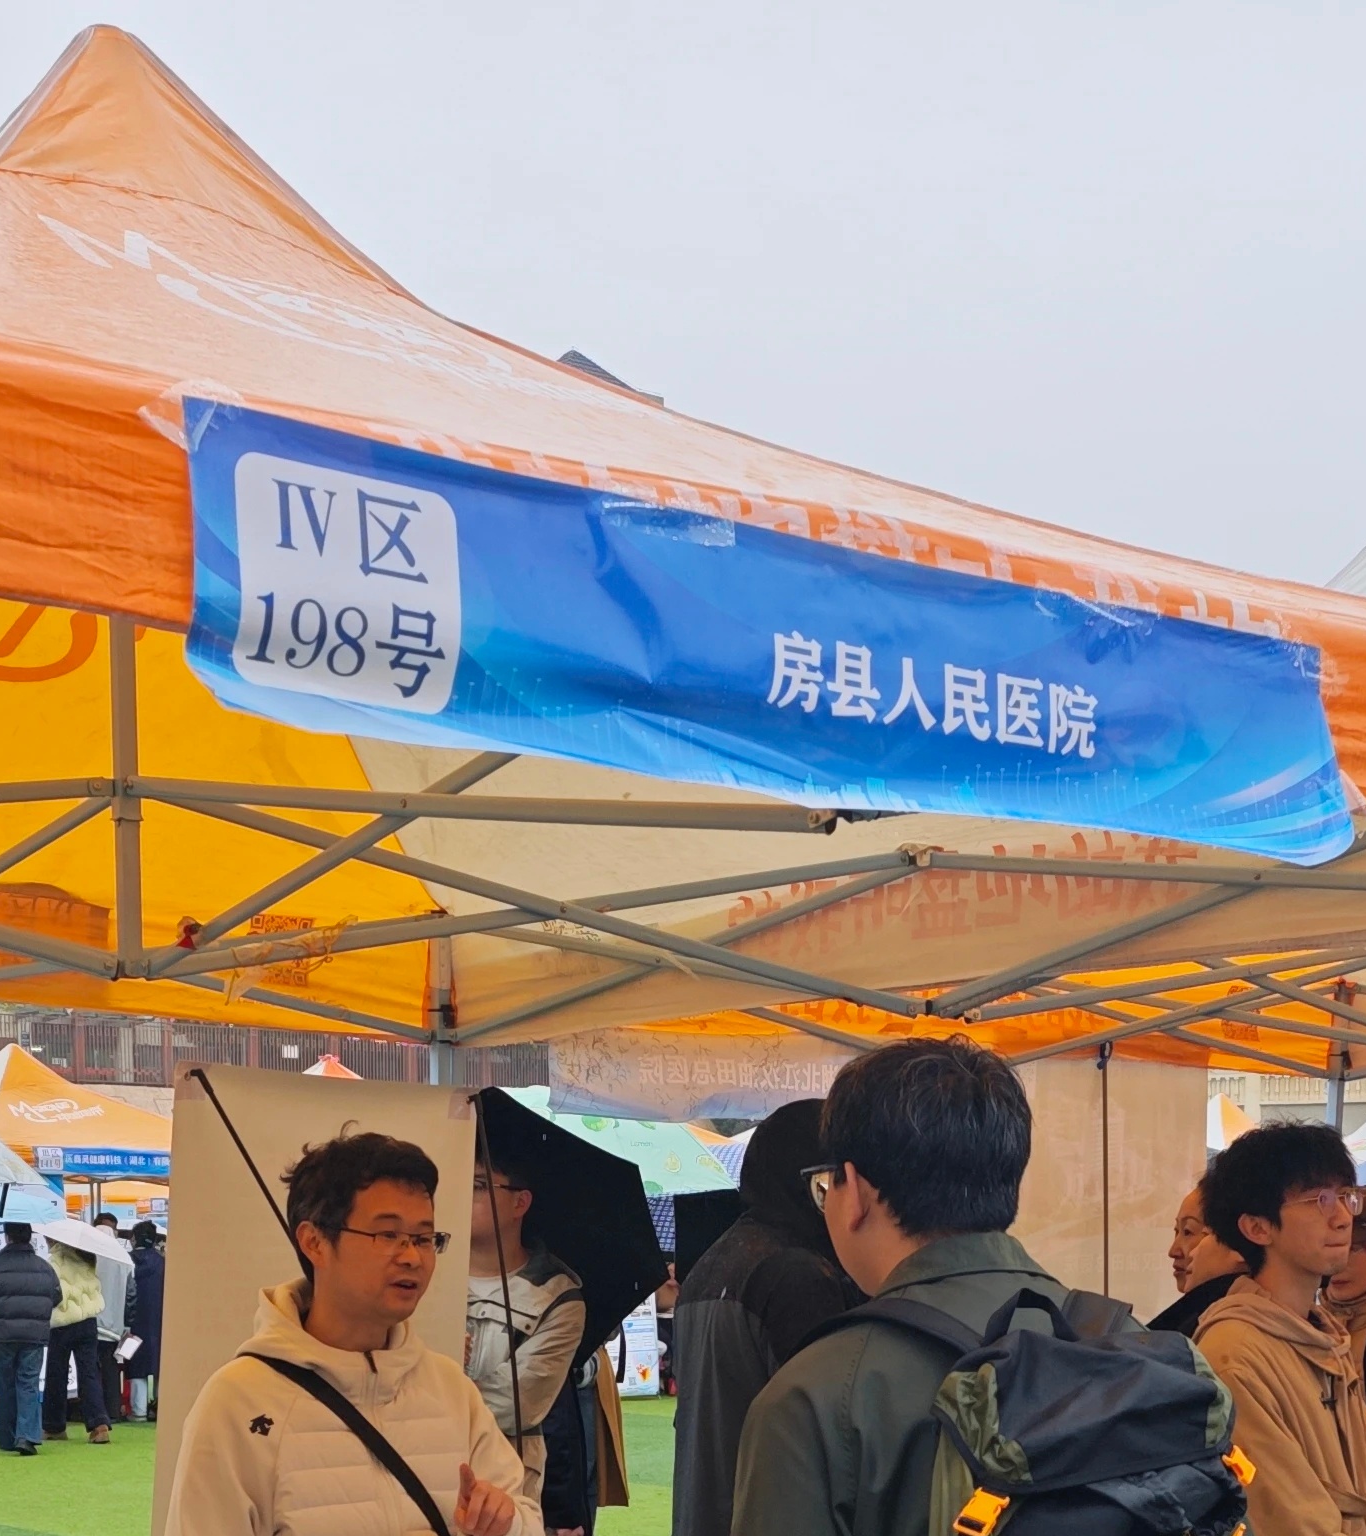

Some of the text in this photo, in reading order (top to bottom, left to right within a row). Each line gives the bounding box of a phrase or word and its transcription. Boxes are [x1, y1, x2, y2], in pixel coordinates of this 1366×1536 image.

[244, 590, 445, 700] 198号
[765, 631, 1098, 759] 房县人民医院
